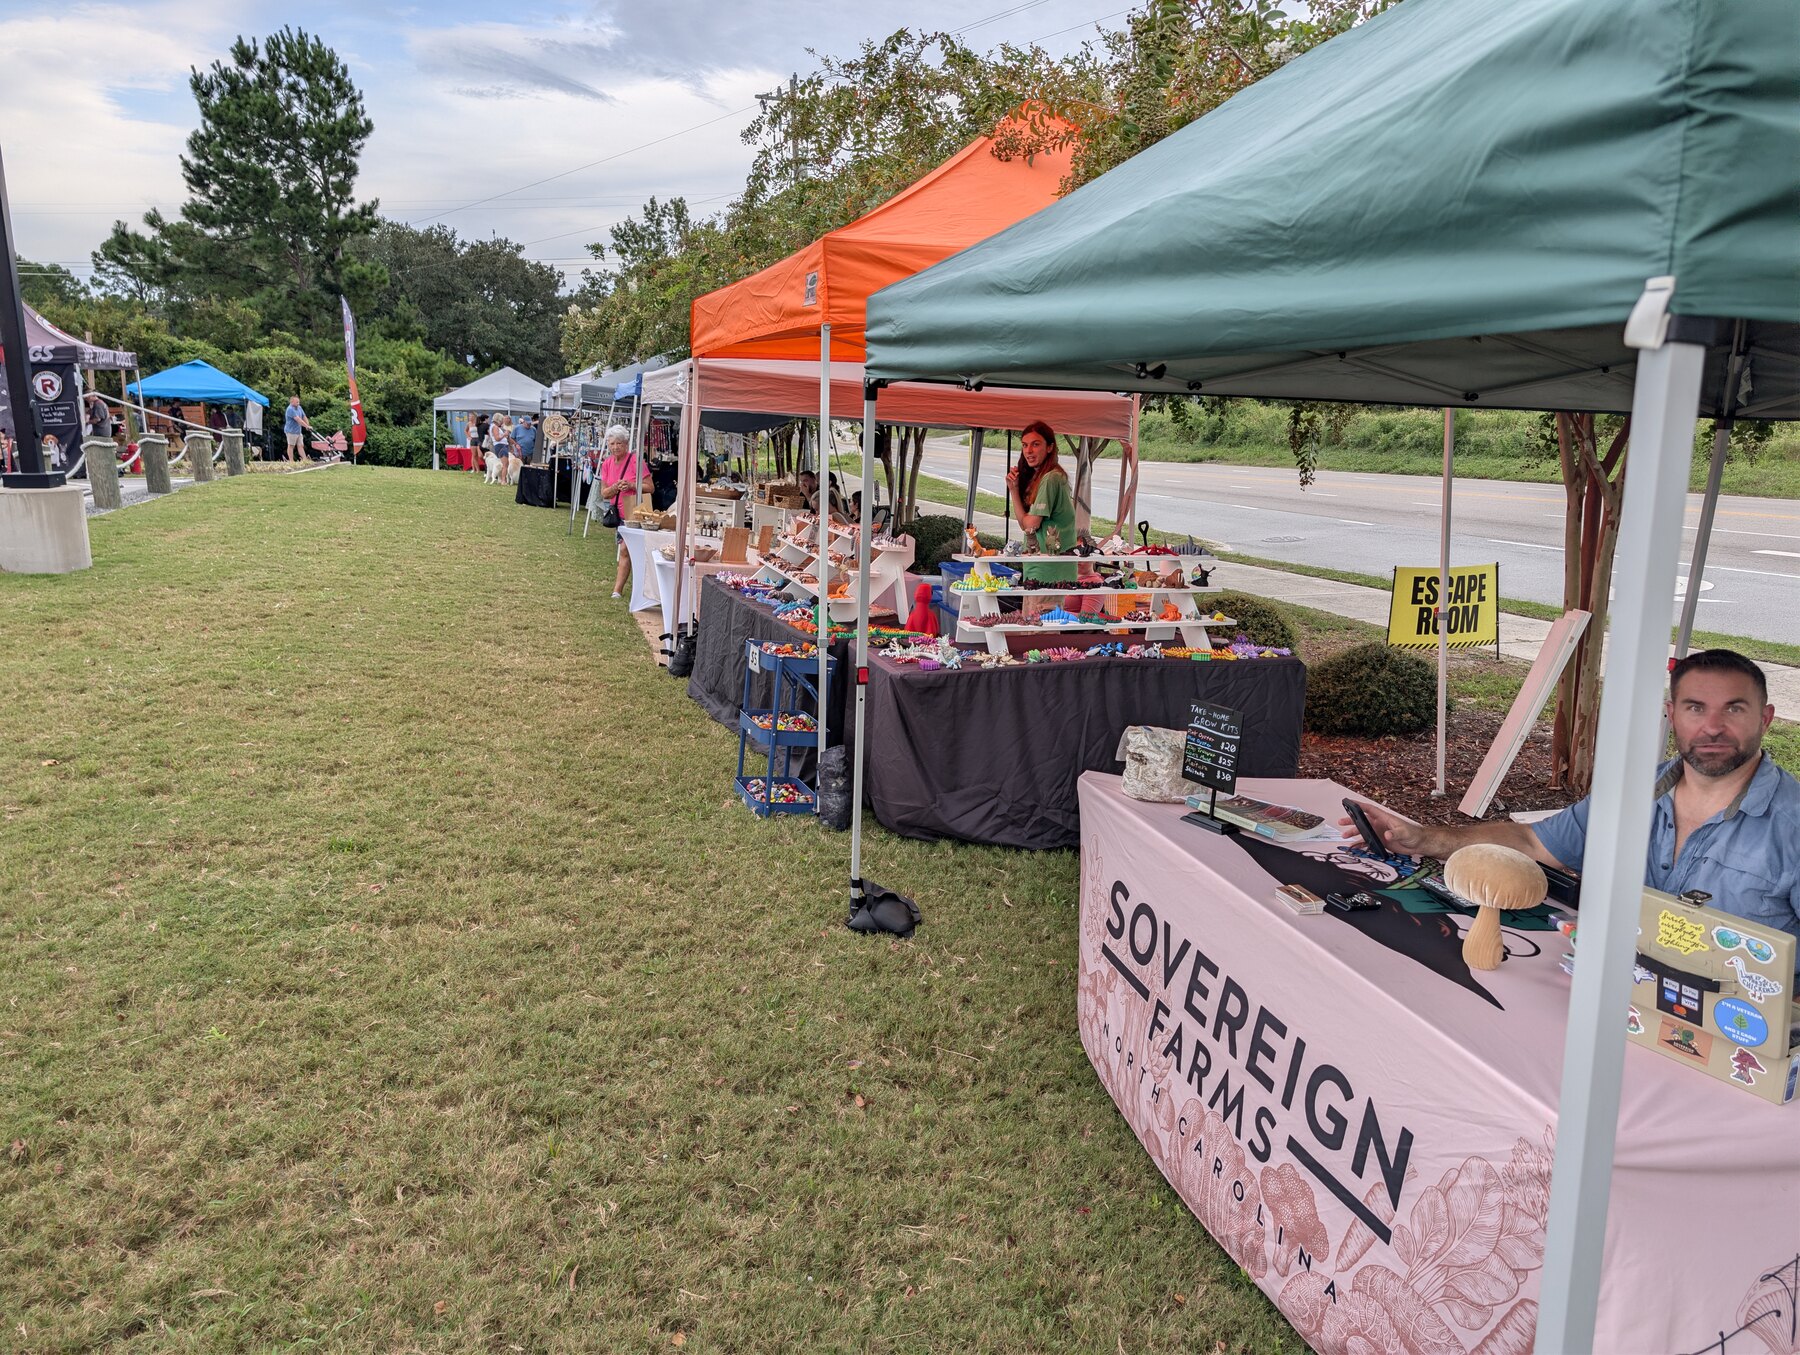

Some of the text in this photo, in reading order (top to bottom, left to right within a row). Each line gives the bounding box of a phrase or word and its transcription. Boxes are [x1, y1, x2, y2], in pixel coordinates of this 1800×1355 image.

[1193, 715, 1239, 735] GROW KITS
[1198, 731, 1215, 742] Oyster
[1220, 741, 1237, 753] $20
[1218, 756, 1234, 767] $25
[1216, 770, 1232, 781] $30
[1684, 999, 1696, 1008] VISA
[1736, 1006, 1763, 1020] VETERAN
[1724, 1025, 1736, 1033] AND
[1740, 1031, 1757, 1042] GROW
[1731, 1033, 1750, 1044] STUFF
[1105, 879, 1415, 1212] SOVEREIGN
[1103, 1022, 1161, 1104] NORTH
[1148, 997, 1278, 1163] FARMS
[1178, 1116, 1337, 1304] CAROLINA
